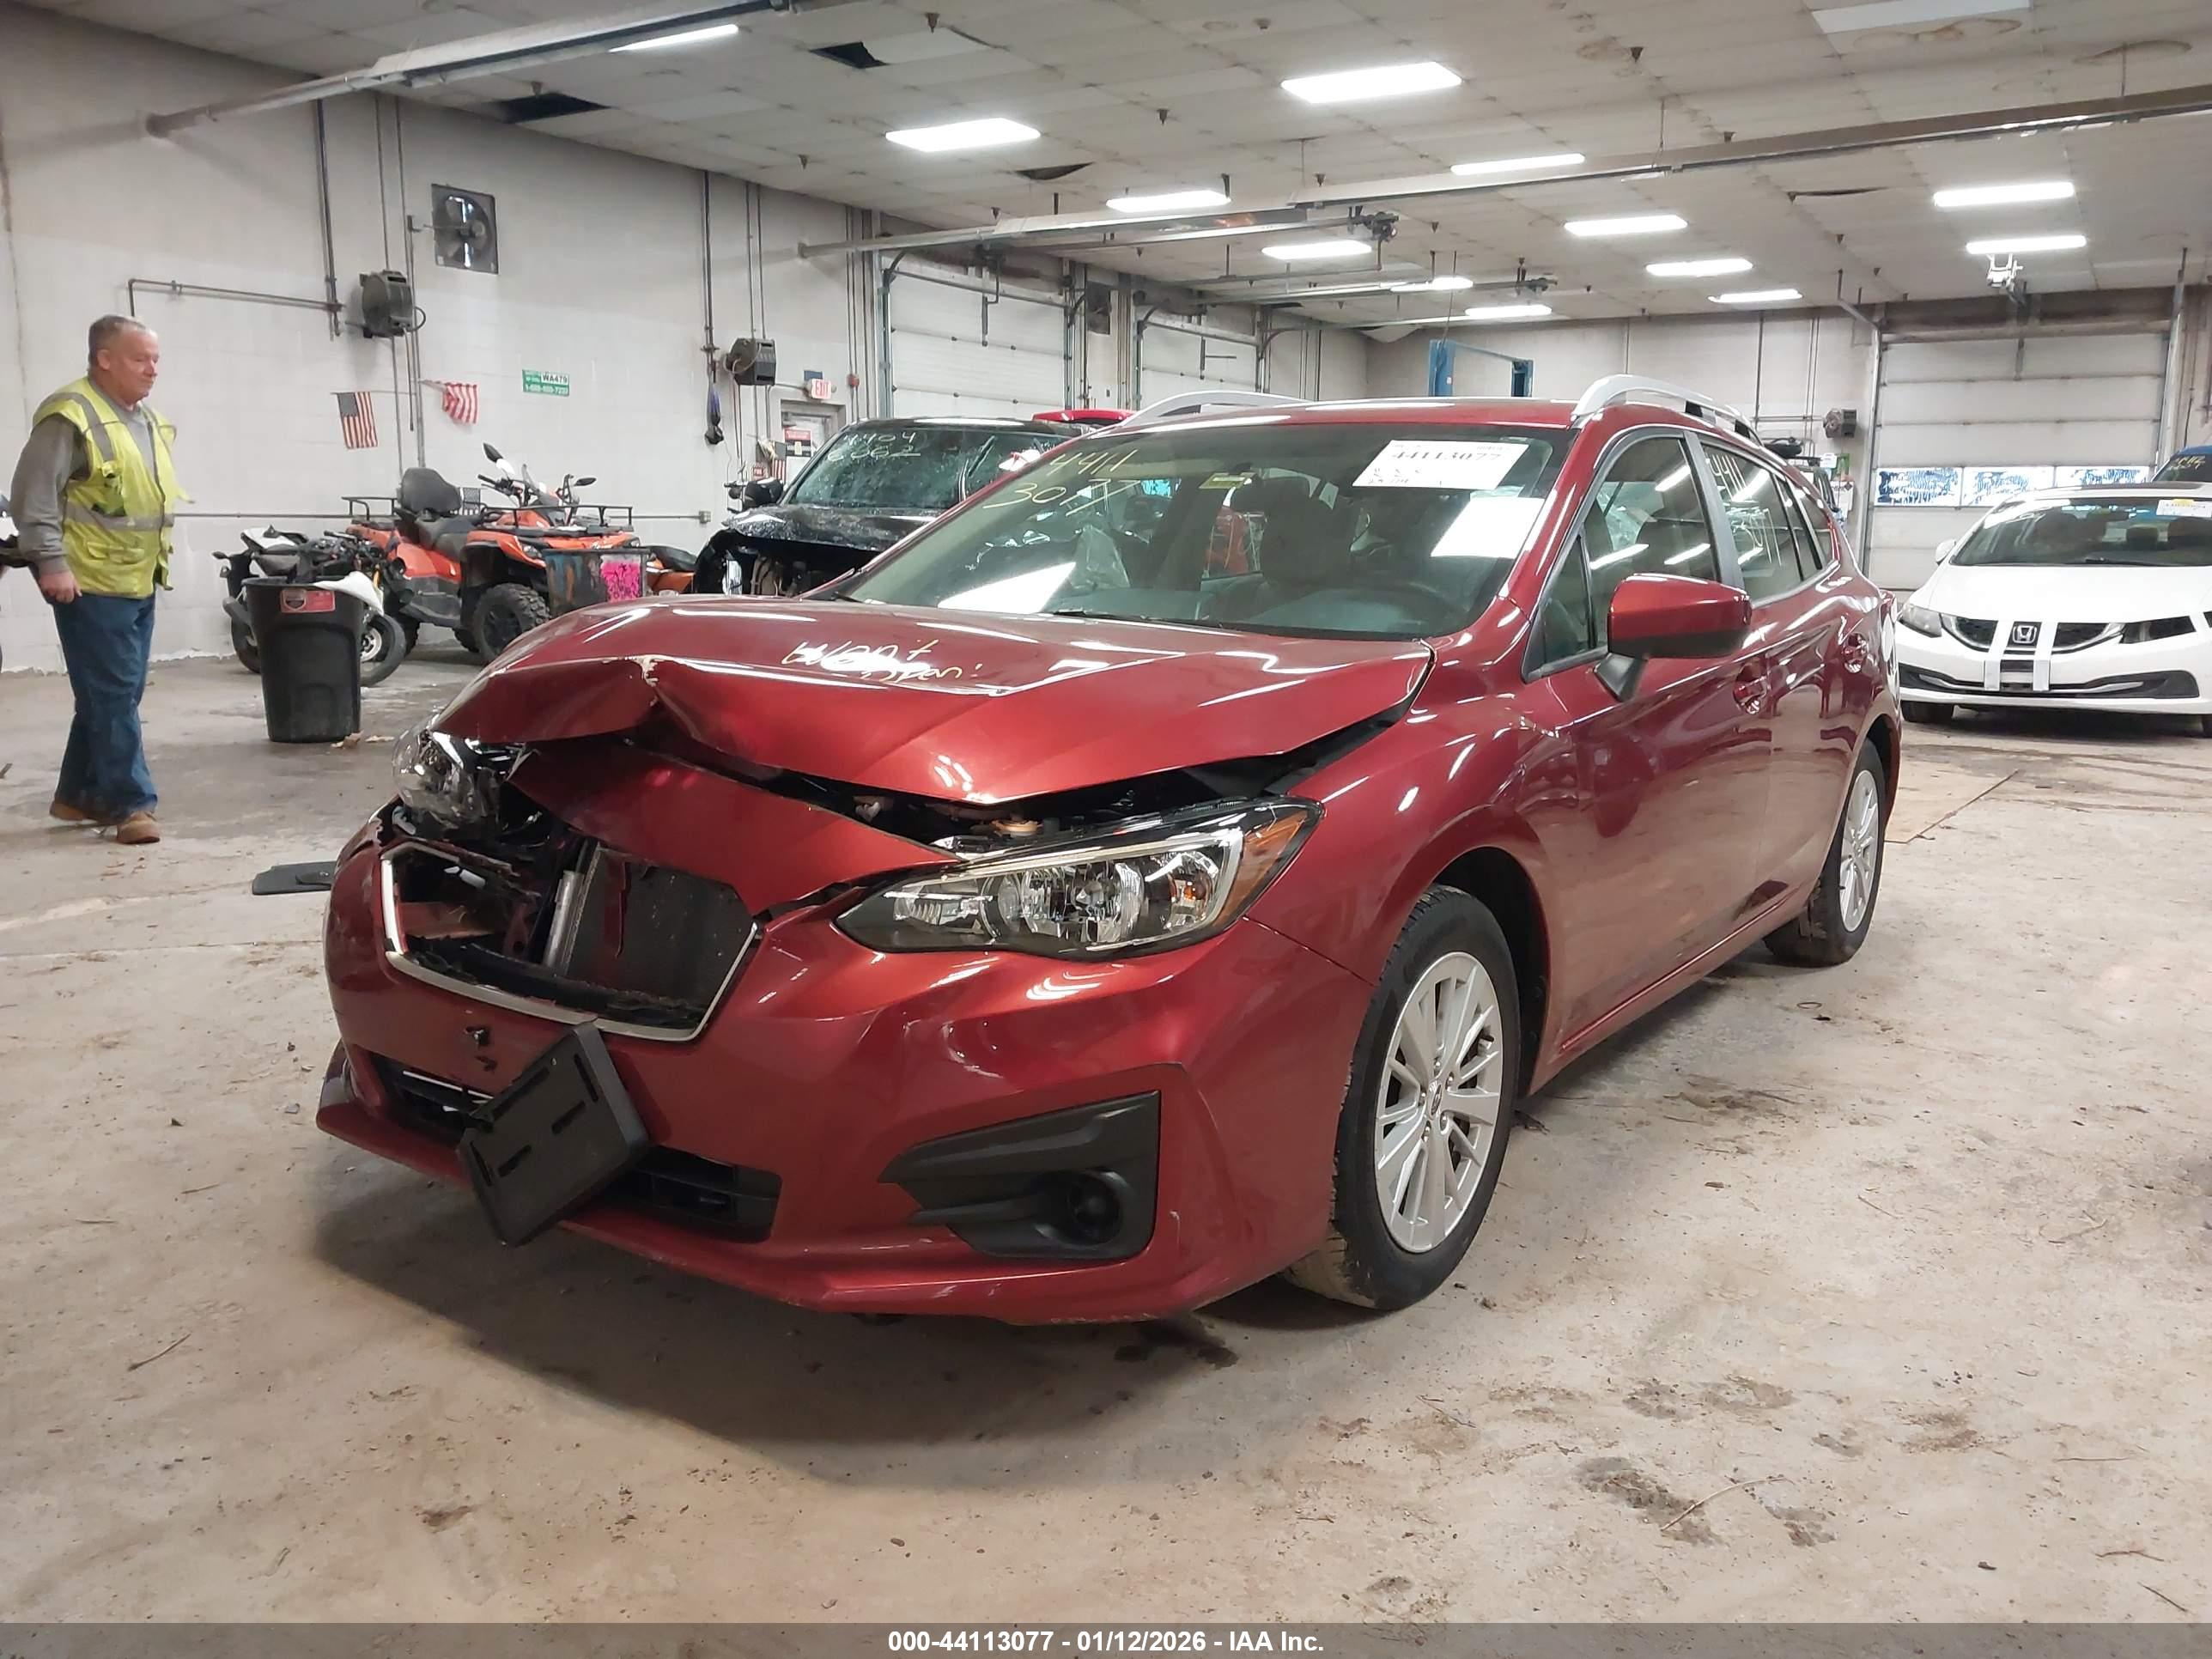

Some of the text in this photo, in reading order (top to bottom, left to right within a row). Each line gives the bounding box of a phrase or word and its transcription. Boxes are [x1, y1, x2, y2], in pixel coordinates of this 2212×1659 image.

[814, 380, 830, 396] EXIT
[1047, 449, 1138, 477] 4411
[981, 477, 1141, 517] 3077
